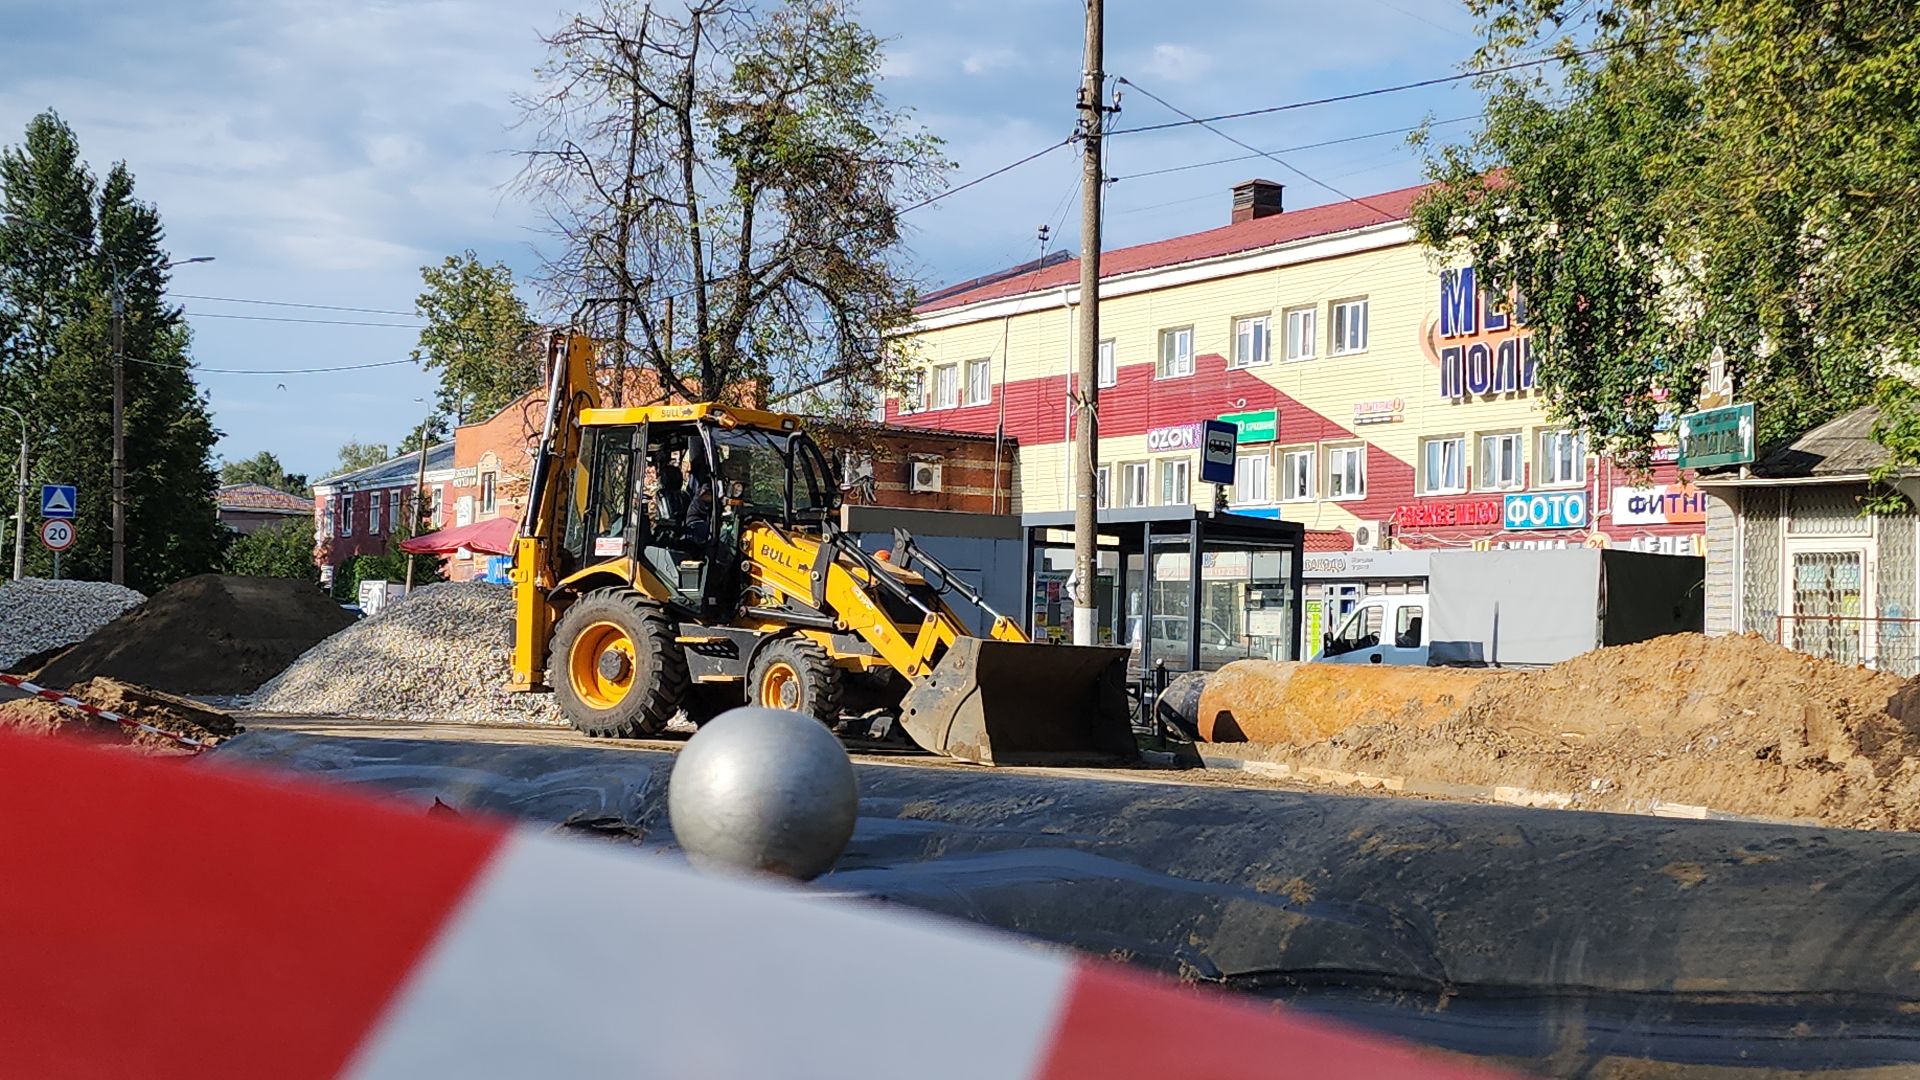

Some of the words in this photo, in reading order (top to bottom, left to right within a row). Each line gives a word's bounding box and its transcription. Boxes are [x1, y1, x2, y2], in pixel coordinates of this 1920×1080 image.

[1149, 427, 1194, 449] OZON
[1507, 494, 1584, 526] ФОТО
[49, 527, 67, 540] 20
[760, 543, 793, 568] BULL
